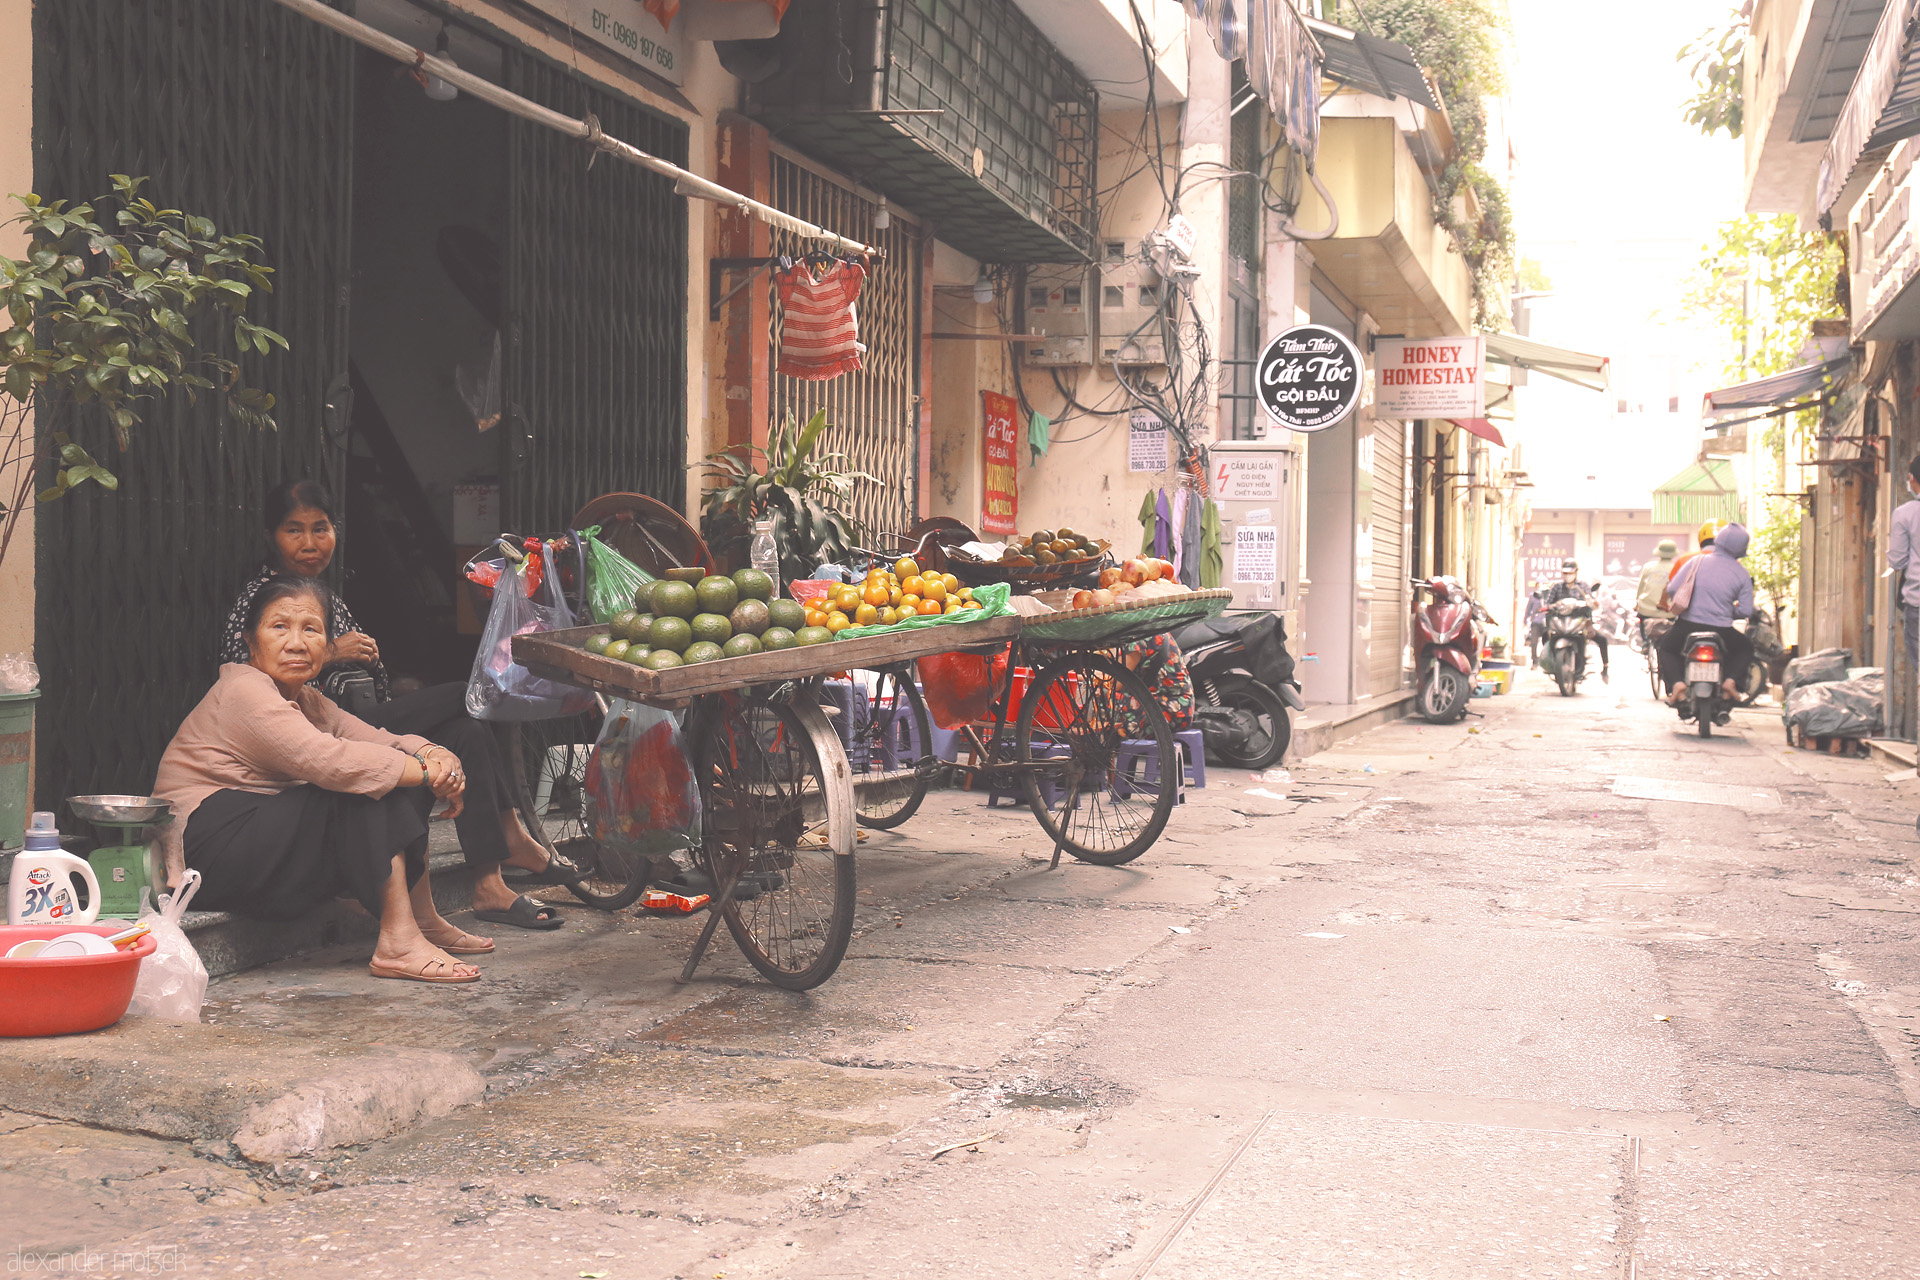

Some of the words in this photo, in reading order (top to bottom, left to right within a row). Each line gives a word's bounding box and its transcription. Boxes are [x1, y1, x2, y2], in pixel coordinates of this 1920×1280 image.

[613, 21, 638, 50] 0969
[640, 36, 656, 60] 197
[656, 46, 673, 70] 658
[1402, 346, 1462, 364] HONEY
[1264, 358, 1305, 386] Cắt
[1306, 354, 1352, 382] Tóc
[1382, 367, 1478, 386] HOMESTAY
[1276, 387, 1304, 404] GỘI
[1257, 529, 1275, 542] NHÀ
[1530, 557, 1562, 570] POKER
[1237, 572, 1274, 580] 0966.730.283
[27, 870, 52, 879] Attack
[21, 882, 55, 917] 3X
